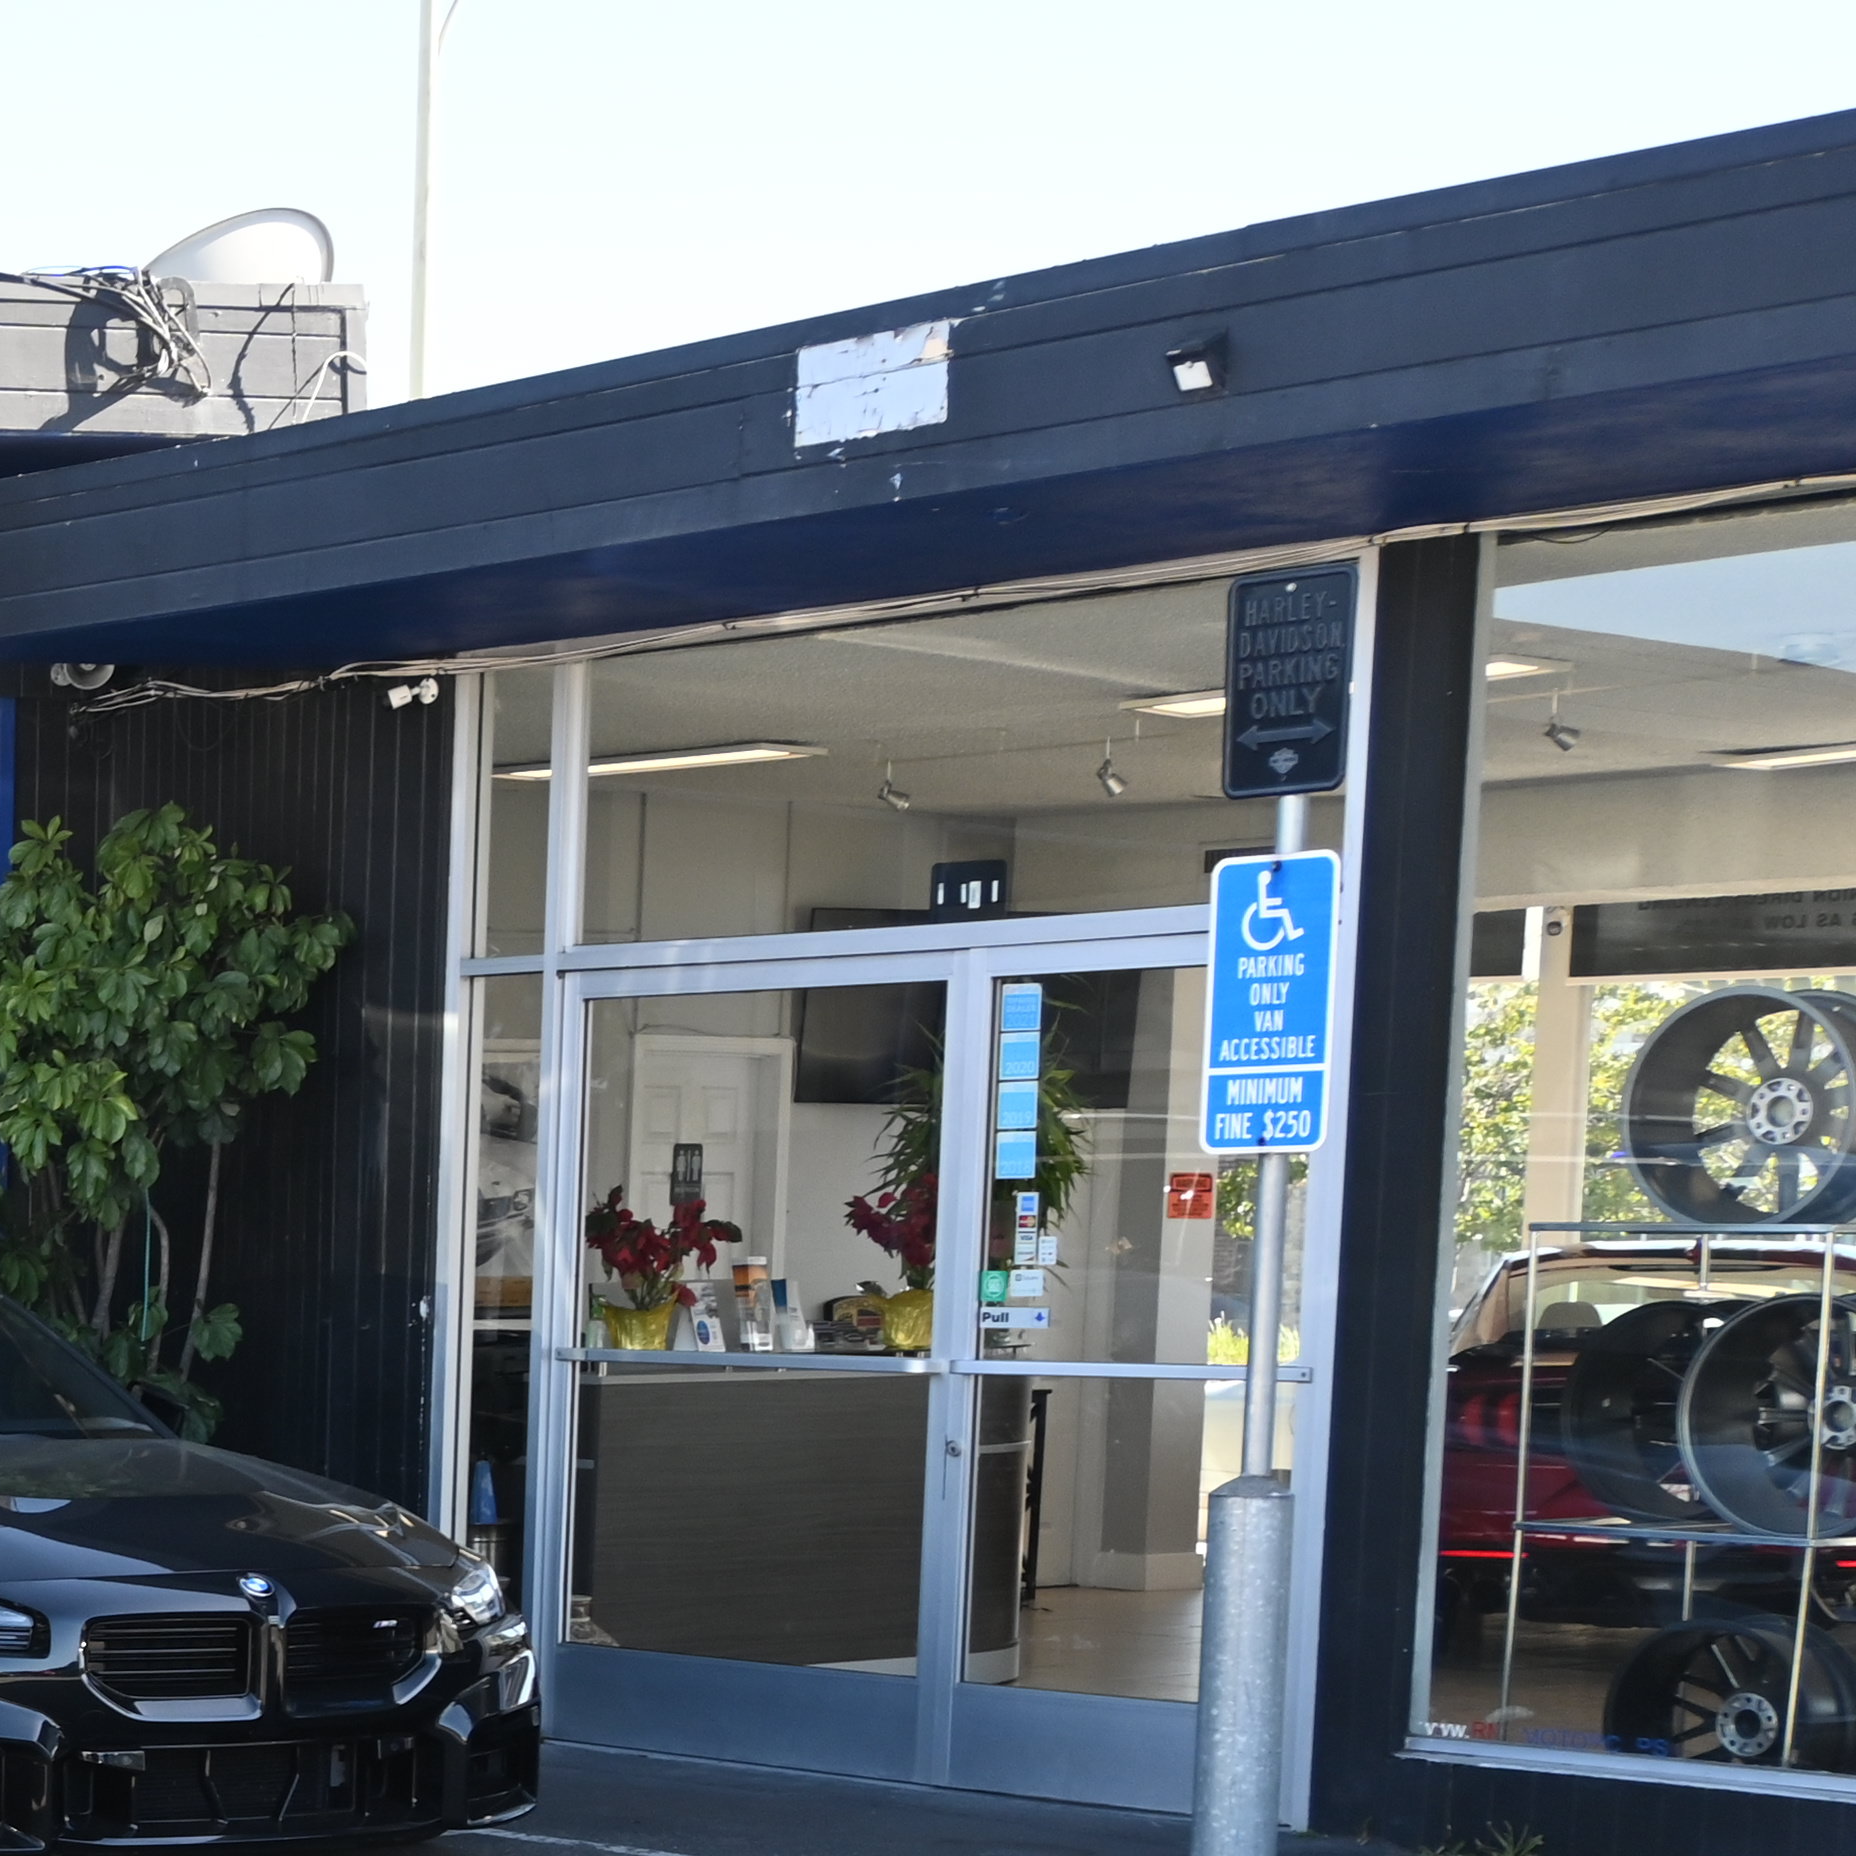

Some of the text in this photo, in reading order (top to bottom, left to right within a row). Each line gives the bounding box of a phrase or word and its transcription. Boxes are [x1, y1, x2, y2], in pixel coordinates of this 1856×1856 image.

[1245, 592, 1336, 626] HARLEY-
[1239, 653, 1338, 690] PARKING
[1251, 684, 1325, 719] ONLY
[1238, 953, 1305, 979] PARKING
[1249, 982, 1289, 1006] ONLY
[1254, 1010, 1284, 1032] VAN
[1219, 1035, 1316, 1061] ACCESSIBLE
[1005, 1061, 1035, 1075] 2020
[1227, 1077, 1303, 1105] MINIMUM
[1002, 1110, 1032, 1124] 2019
[1215, 1109, 1311, 1141] FINE $250
[982, 1312, 1009, 1322] Pull
